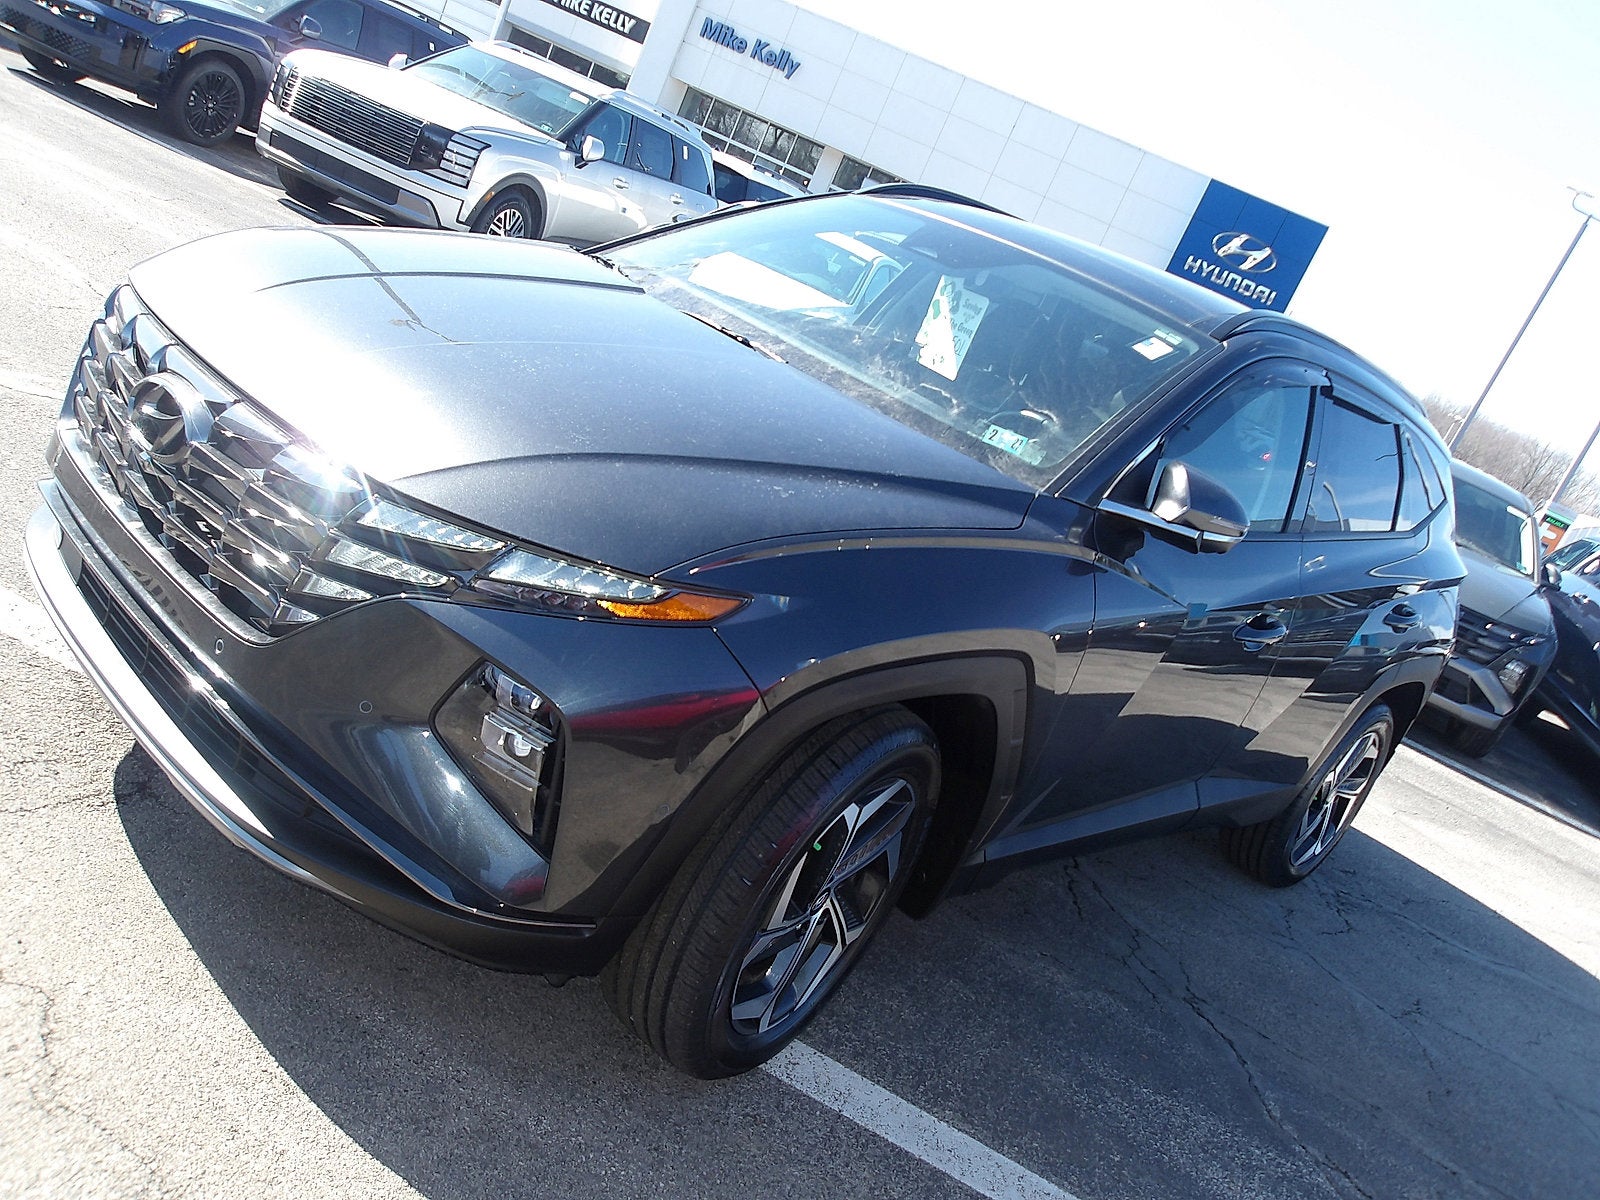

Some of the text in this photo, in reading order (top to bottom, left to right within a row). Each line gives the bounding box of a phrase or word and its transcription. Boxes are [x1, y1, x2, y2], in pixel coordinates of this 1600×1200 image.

[552, 0, 637, 34] IKE KELLY
[699, 16, 801, 80] Mike Kelly
[1183, 255, 1277, 306] HYUNDAI
[988, 428, 999, 441] 2
